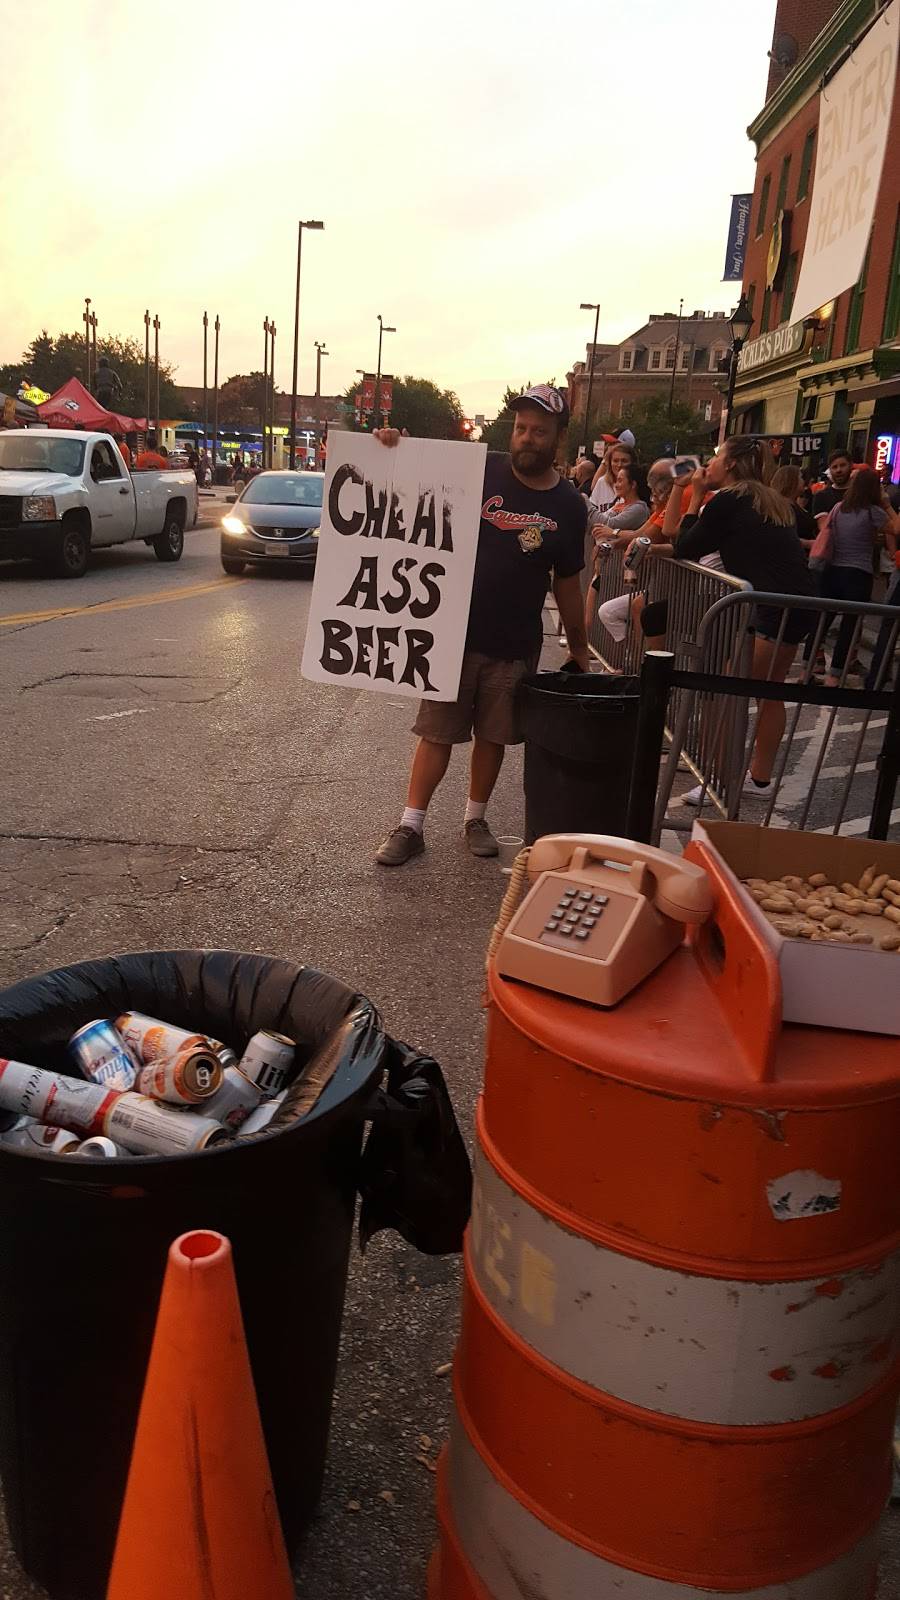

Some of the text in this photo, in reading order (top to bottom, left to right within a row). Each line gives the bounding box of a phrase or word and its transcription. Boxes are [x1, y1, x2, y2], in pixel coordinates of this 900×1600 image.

[819, 43, 893, 181] ENTER
[813, 144, 878, 257] HERE
[730, 198, 750, 279] Hampton Inn
[773, 327, 794, 358] PUB
[791, 436, 822, 456] Lite
[875, 439, 890, 471] OPE
[336, 556, 446, 619] ASS
[318, 619, 440, 692] BEER
